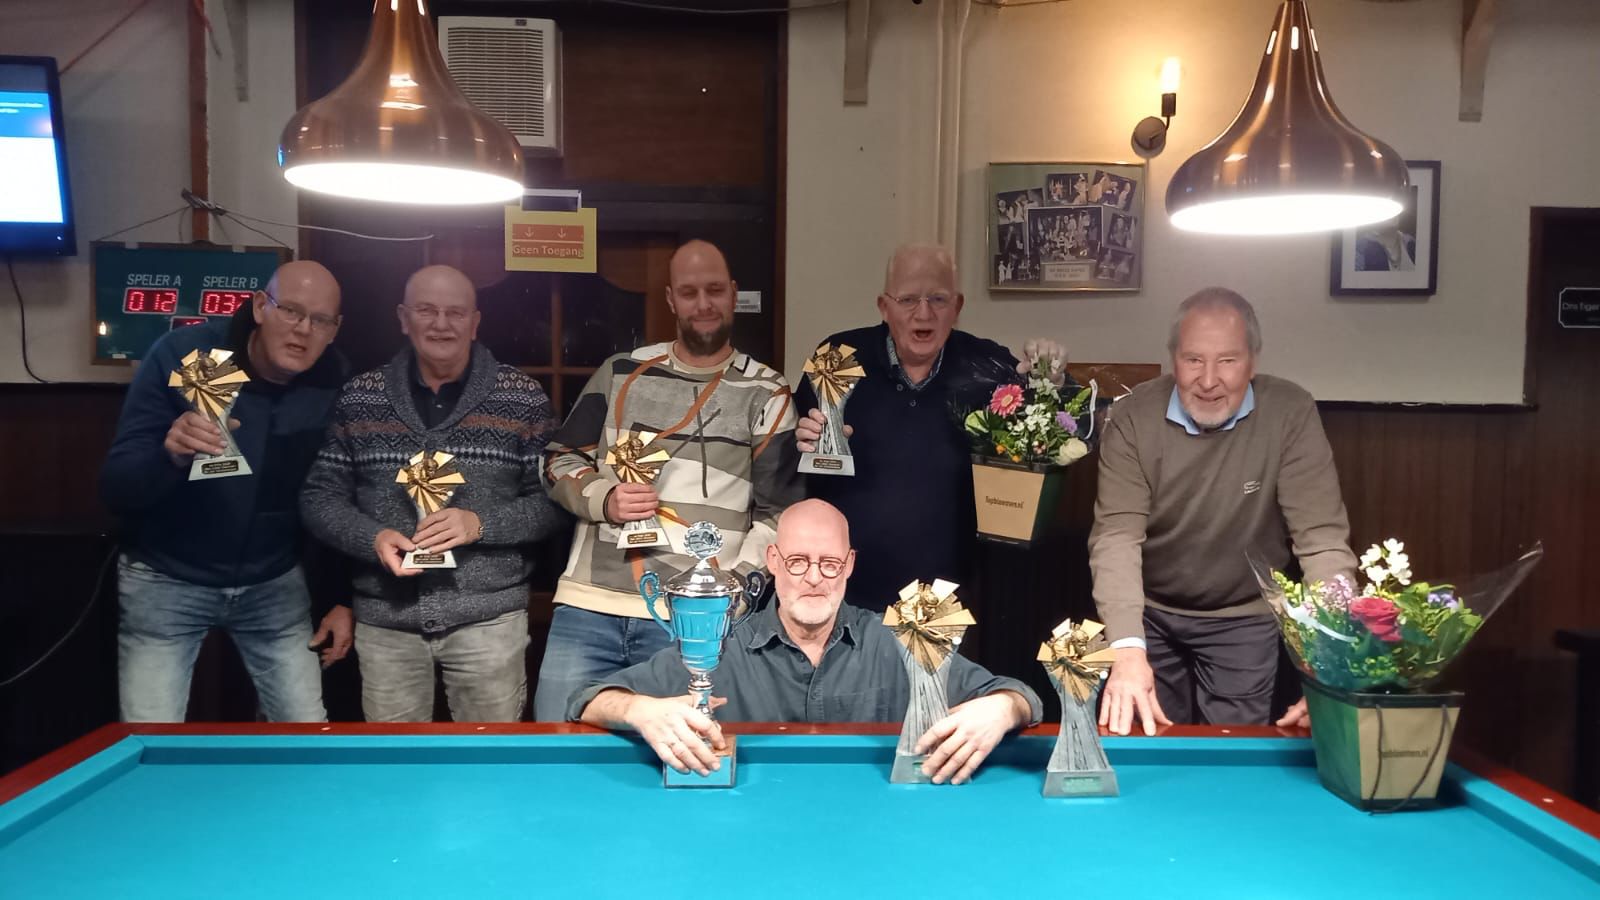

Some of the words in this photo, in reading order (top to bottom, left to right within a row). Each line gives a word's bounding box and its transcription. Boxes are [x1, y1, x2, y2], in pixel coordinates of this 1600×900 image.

[513, 244, 540, 255] Geen
[542, 245, 584, 258] Toegang
[126, 273, 170, 287] SPELER
[172, 274, 182, 287] A
[202, 275, 247, 289] SPELER
[249, 277, 259, 289] B
[127, 290, 177, 312] 012
